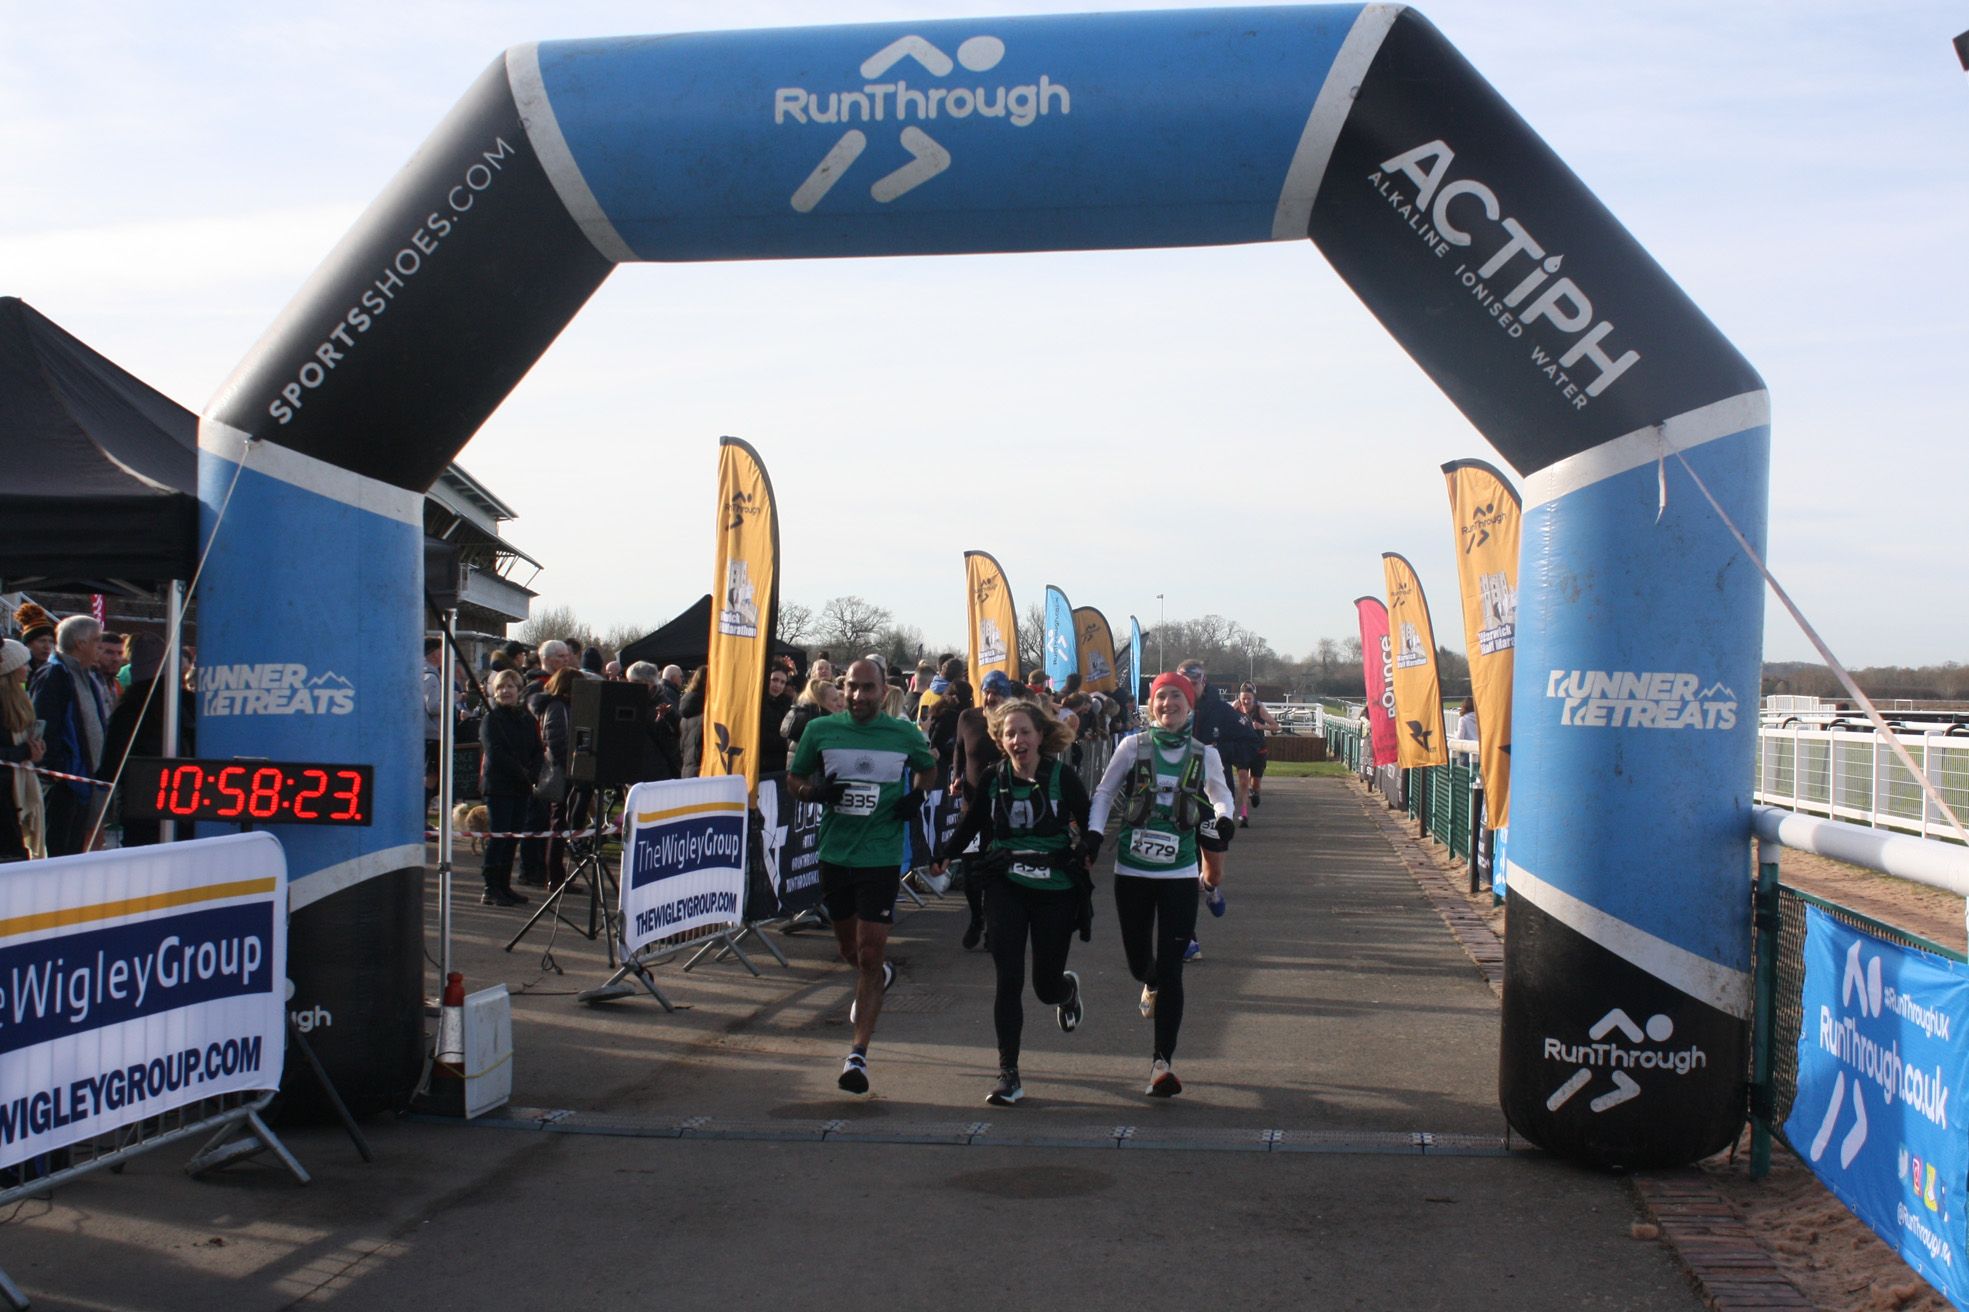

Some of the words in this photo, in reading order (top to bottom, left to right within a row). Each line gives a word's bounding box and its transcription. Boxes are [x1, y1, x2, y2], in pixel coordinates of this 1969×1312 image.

[774, 74, 1070, 127] RunThrough
[269, 136, 515, 424] SPORTSSHOES.COM
[1368, 171, 1450, 258] ALKALINE
[1454, 264, 1523, 338] IONISED
[1531, 346, 1588, 410] WATER
[1495, 636, 1515, 651] Mara
[204, 688, 355, 717] RETREATS
[1546, 669, 1699, 700] RUNNER
[1561, 697, 1739, 730] RETREATS
[835, 793, 877, 808] 335
[637, 827, 739, 872] TheWigleyGroup
[1131, 840, 1176, 857] 2779
[636, 891, 737, 937] THEWIGLEYGROUP.COM
[1544, 1037, 1706, 1075] RunThrough
[1820, 1004, 1949, 1131] RunThrough.co.uk
